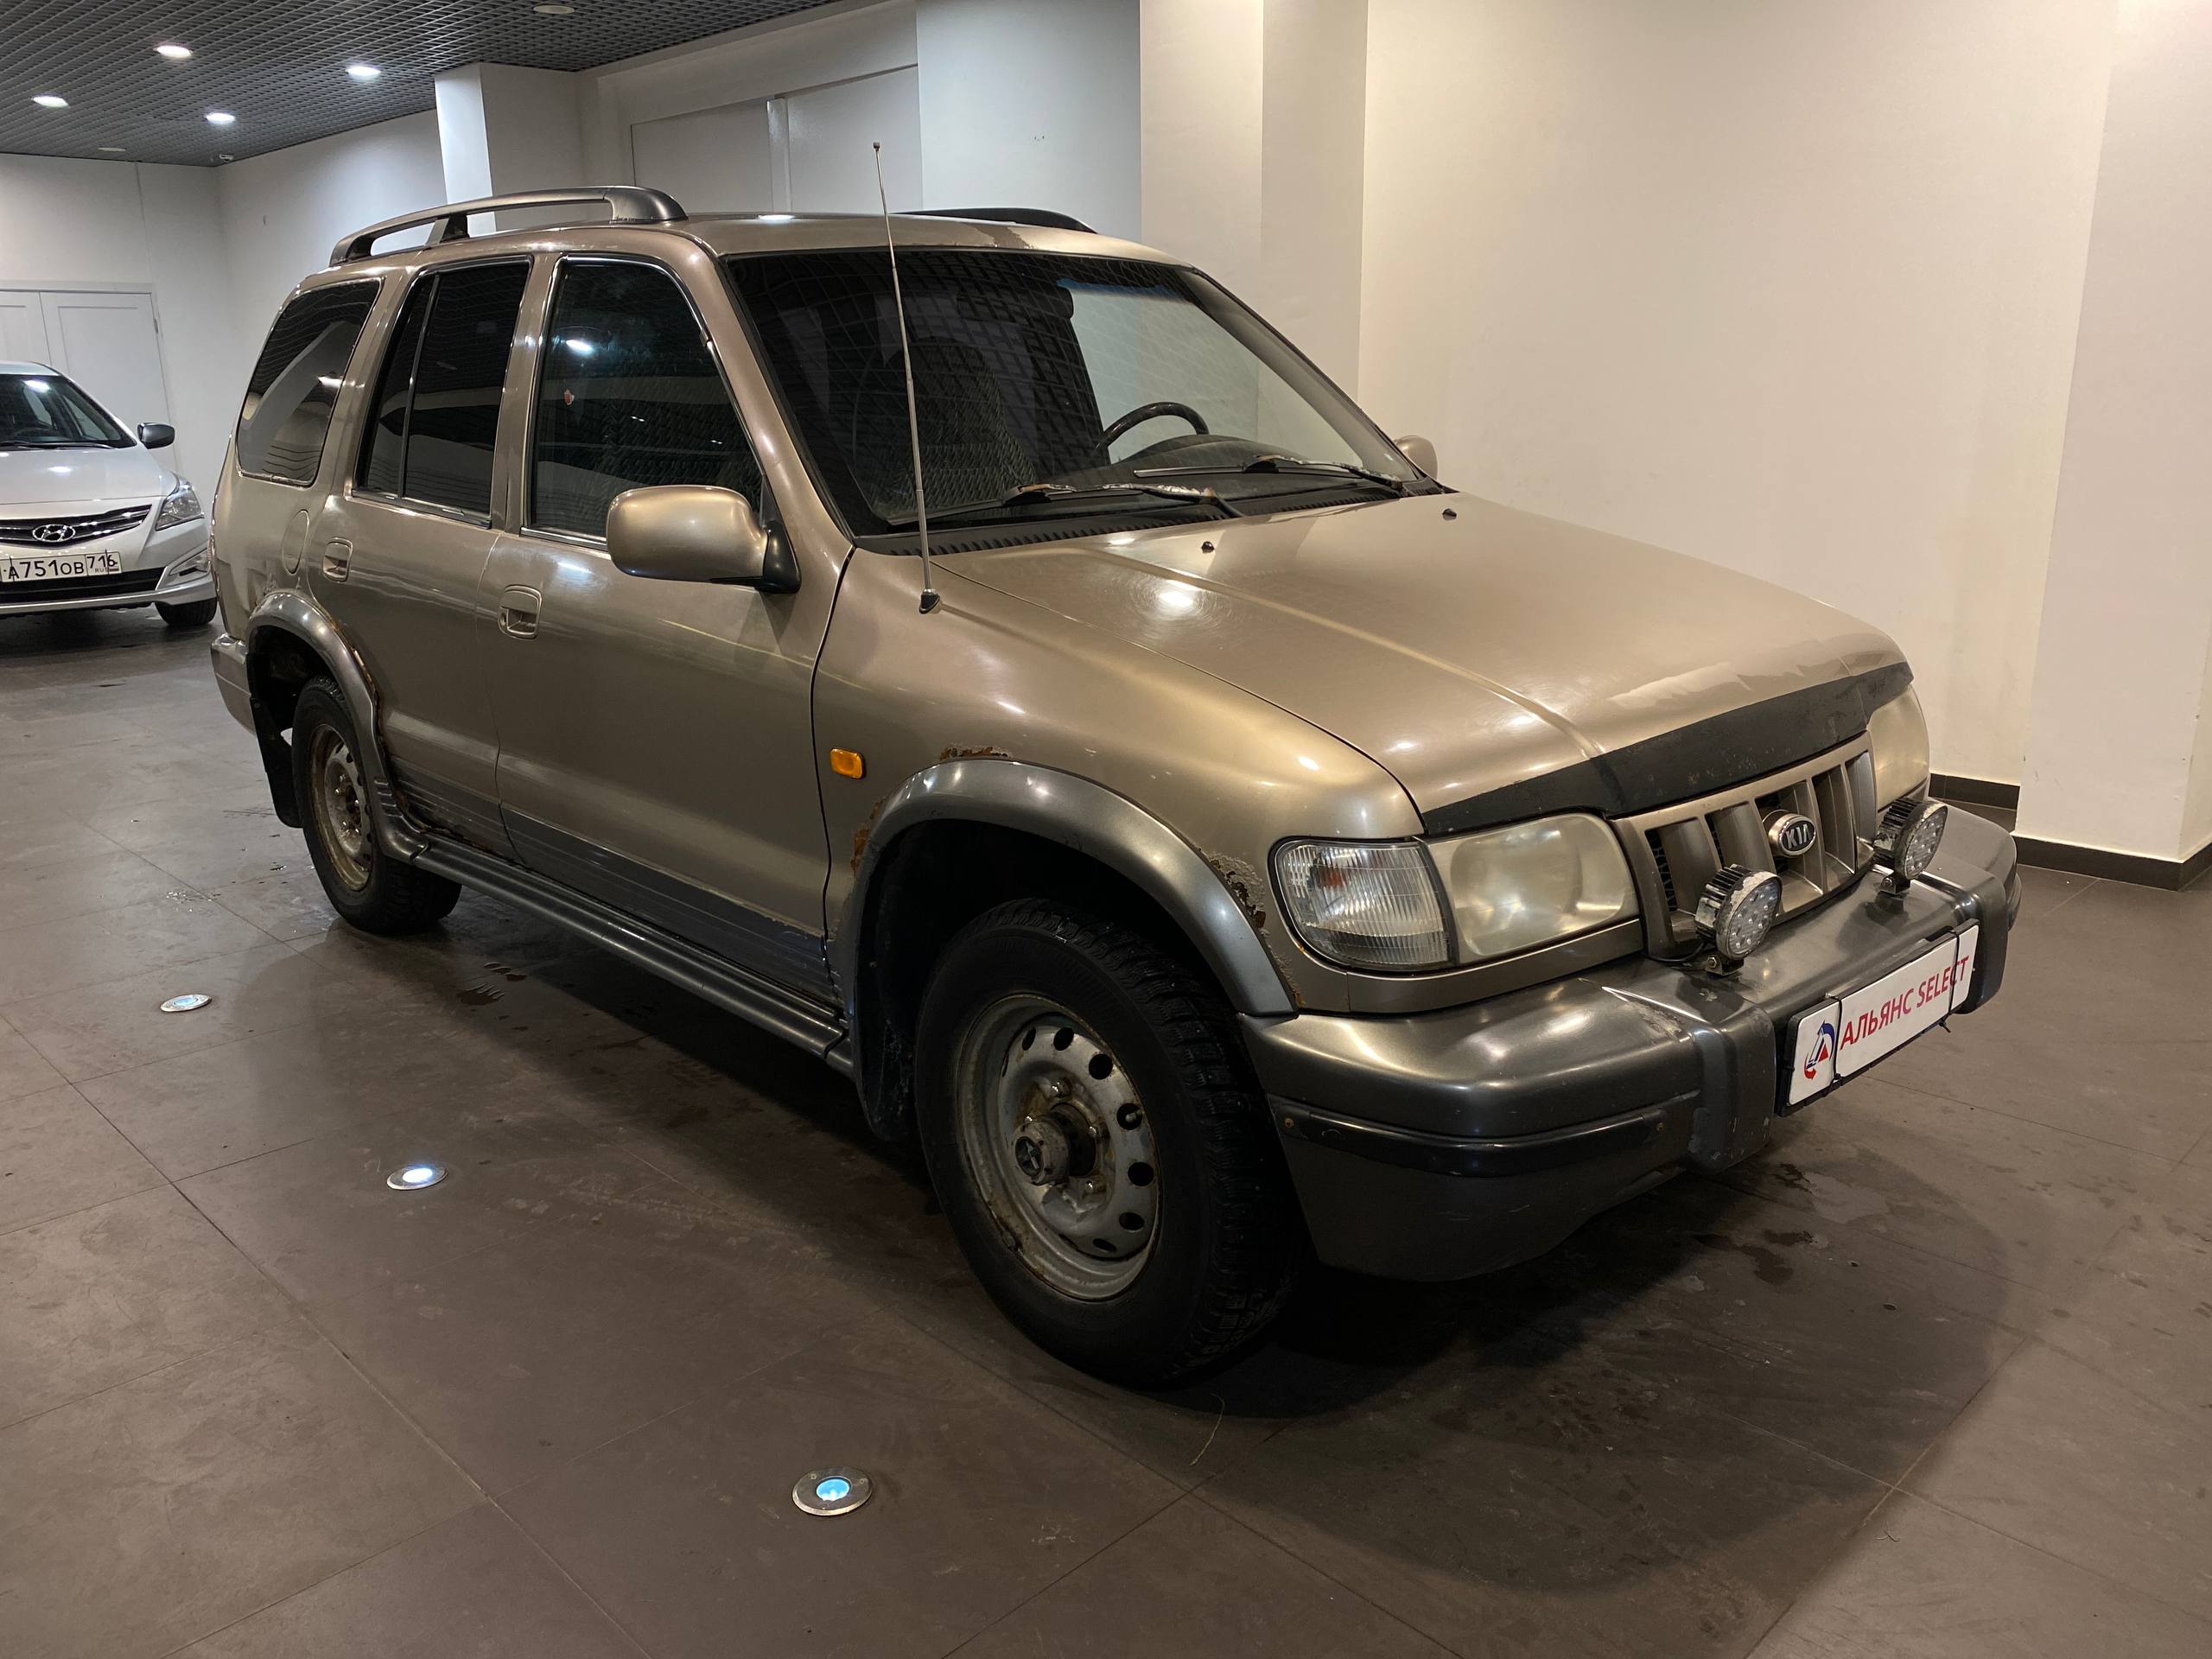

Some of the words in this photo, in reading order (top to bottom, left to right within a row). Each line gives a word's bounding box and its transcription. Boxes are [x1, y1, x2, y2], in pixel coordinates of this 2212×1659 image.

[86, 555, 116, 569] 716
[1785, 823, 1812, 849] KIA
[1840, 988, 1914, 1051] АЛЬЯНС
[1916, 957, 1969, 1008] SELECT
